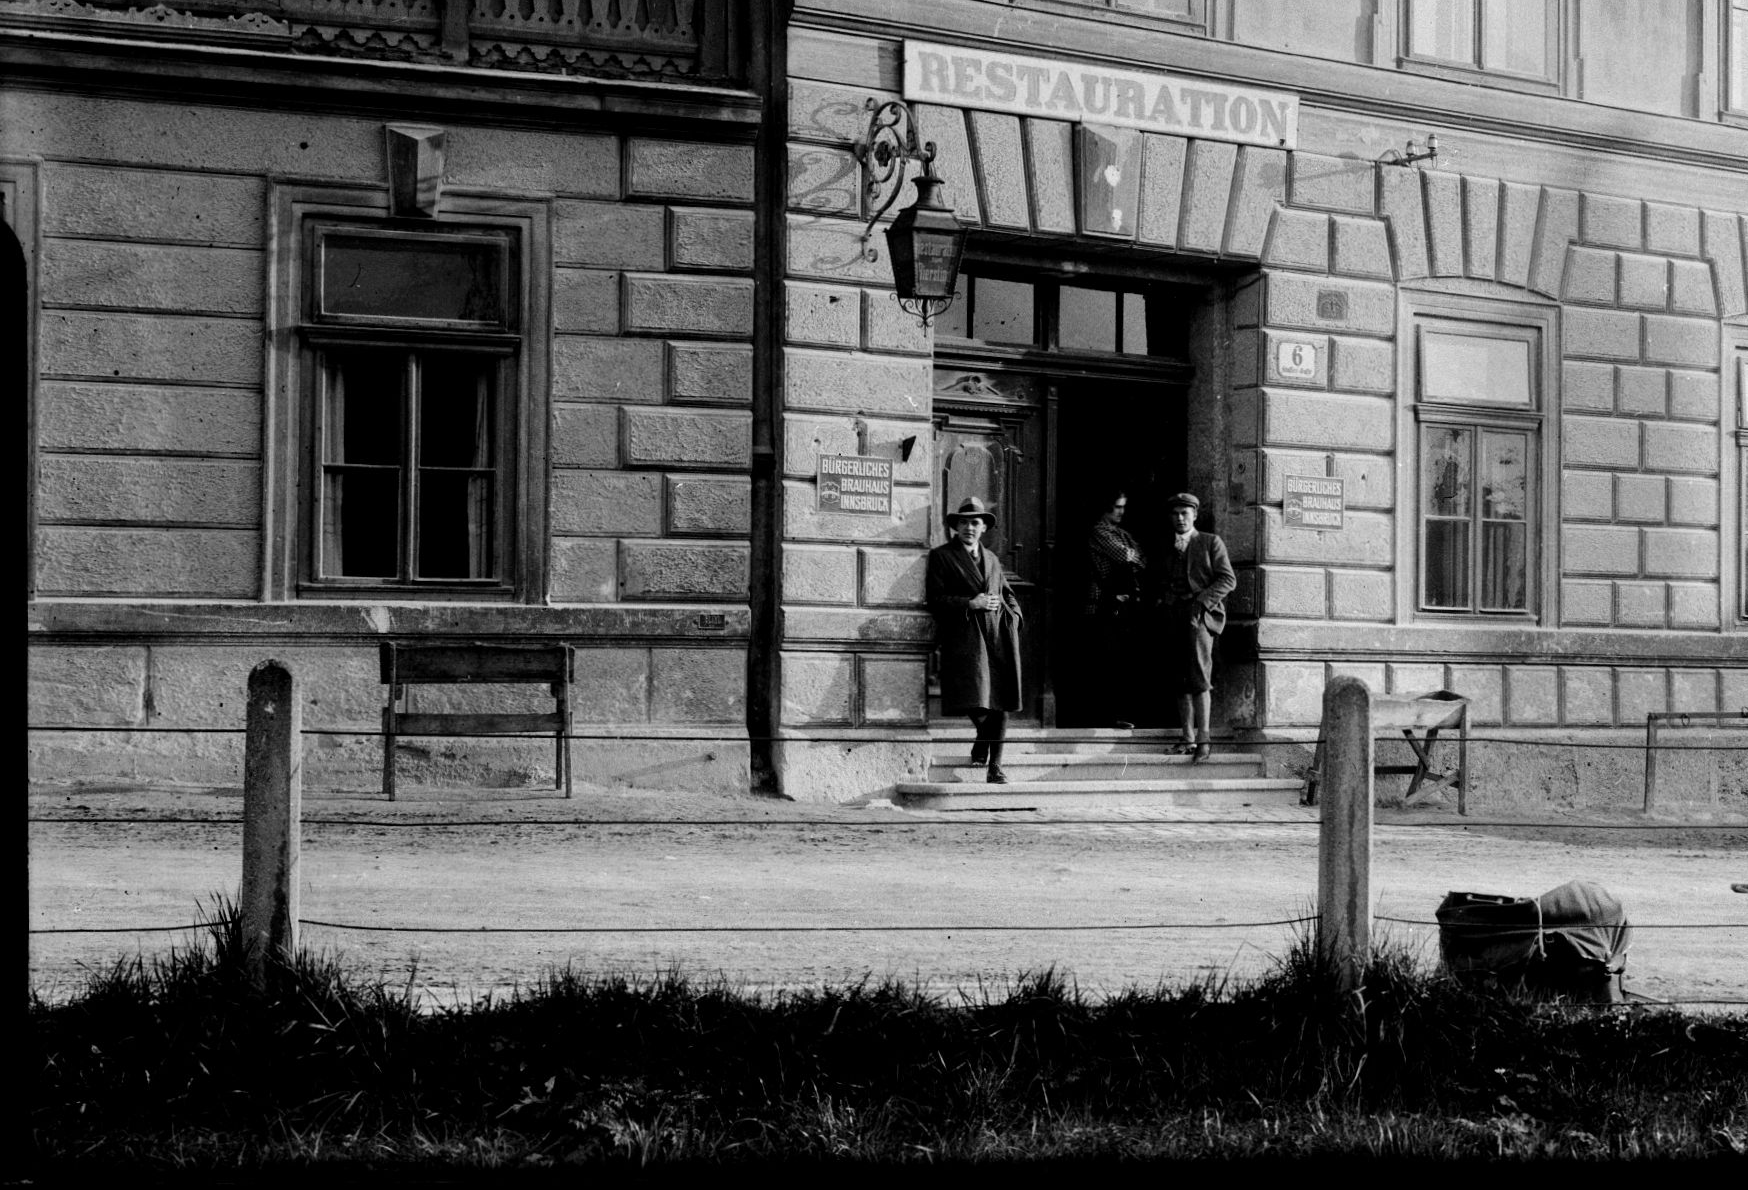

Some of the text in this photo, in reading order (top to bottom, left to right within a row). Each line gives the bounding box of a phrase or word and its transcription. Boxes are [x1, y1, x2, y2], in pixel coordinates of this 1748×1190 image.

[917, 50, 1291, 139] RESTAURATION
[1291, 345, 1303, 366] 6
[822, 456, 890, 478] BÜRGERLICHES
[841, 478, 890, 494] BRAUHAUS
[1287, 476, 1342, 496] BÜRGERLICHES
[840, 495, 890, 512] INNSBRUCK
[1302, 495, 1342, 510] BRAUHAUS
[1302, 511, 1342, 526] INNSBRUCK
